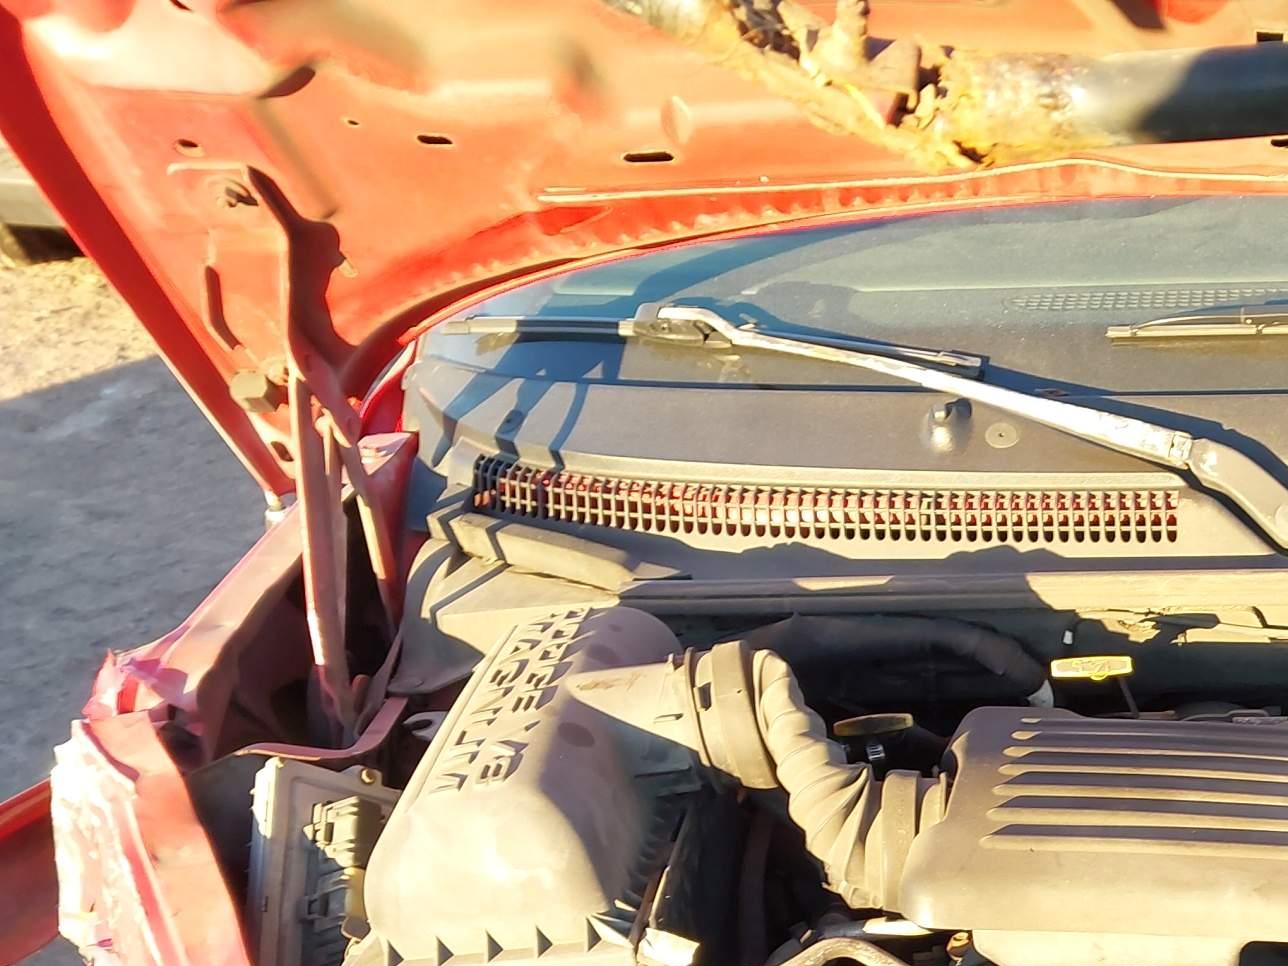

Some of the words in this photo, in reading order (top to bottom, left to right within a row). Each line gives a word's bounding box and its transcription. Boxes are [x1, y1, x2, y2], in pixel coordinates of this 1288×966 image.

[428, 611, 557, 794] MAGNUM
[508, 606, 594, 714] DODGE
[474, 719, 541, 785] V8
